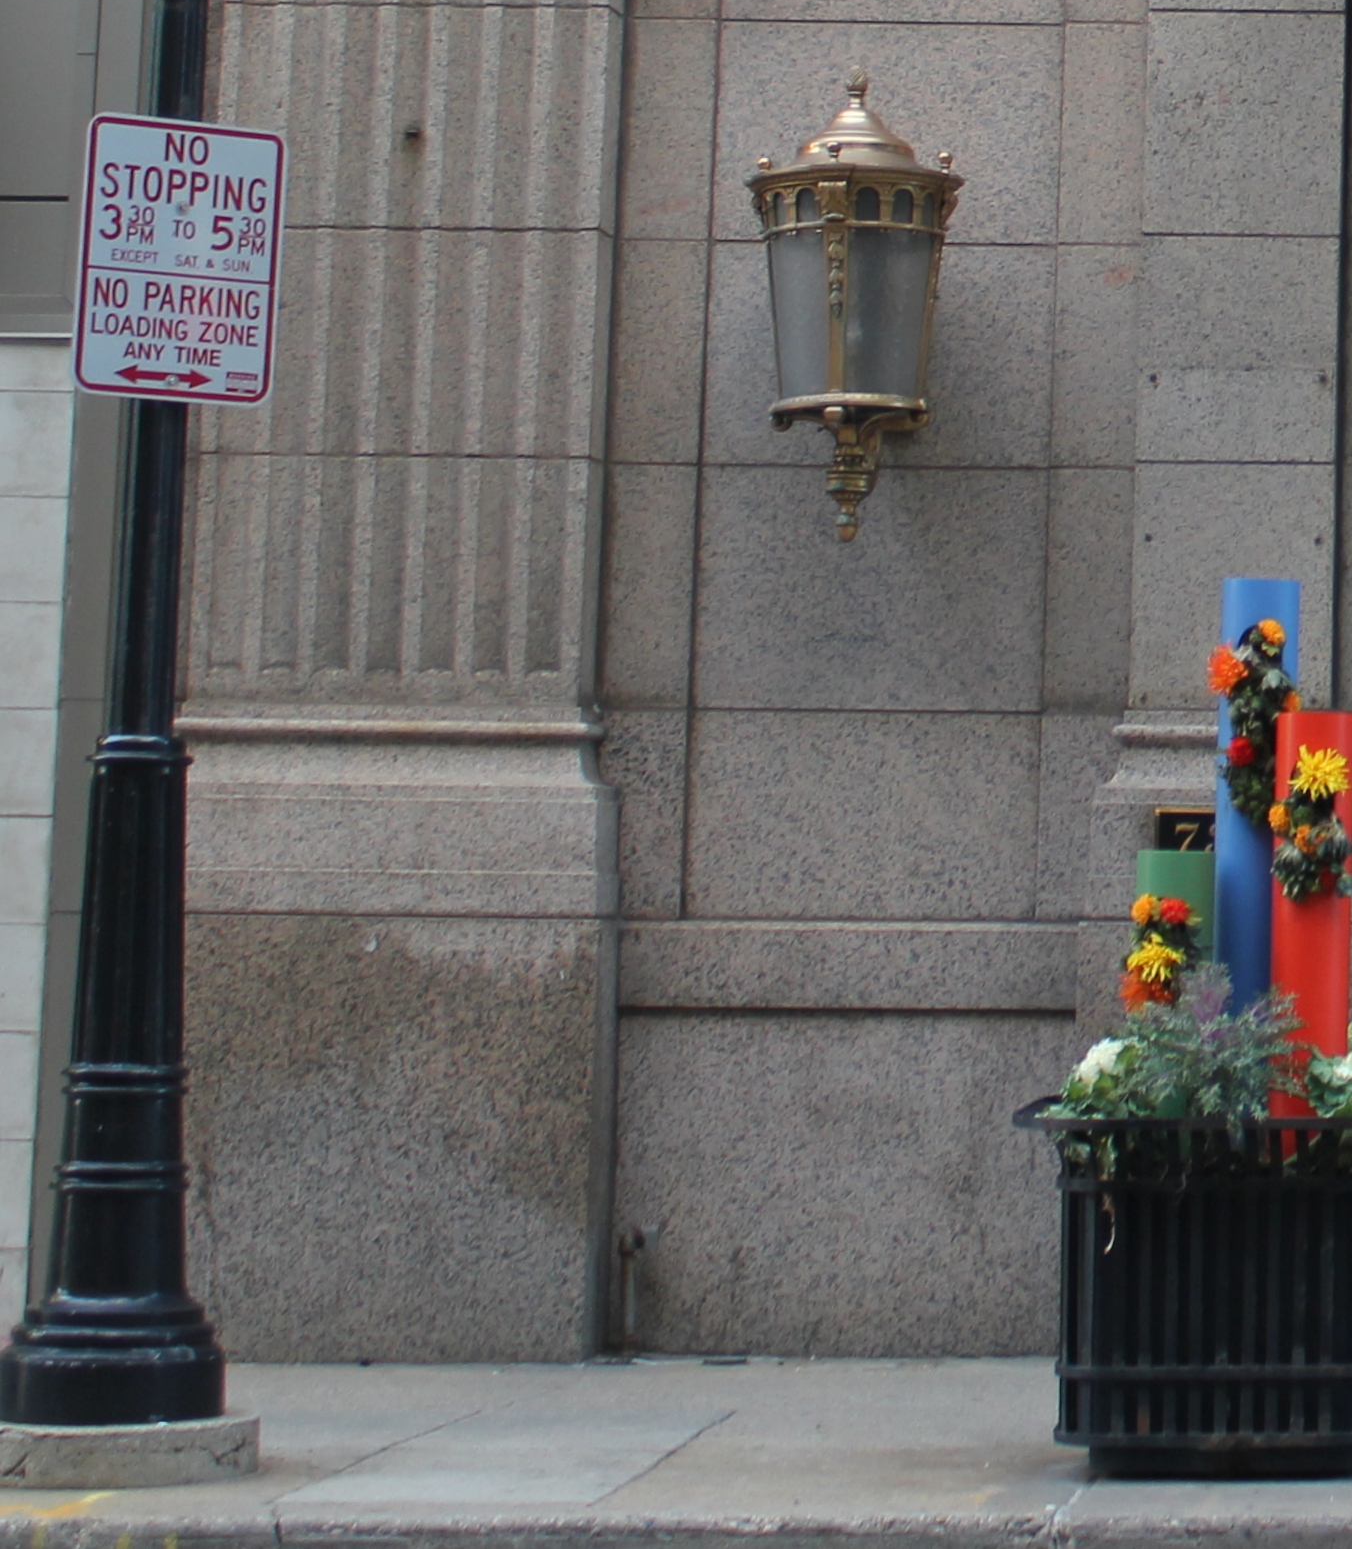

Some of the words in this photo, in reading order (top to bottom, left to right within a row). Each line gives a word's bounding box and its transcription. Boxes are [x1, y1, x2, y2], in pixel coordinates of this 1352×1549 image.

[164, 133, 210, 166] NO
[100, 162, 267, 214] STOPPING
[99, 203, 122, 240] 3
[128, 206, 155, 225] 30
[239, 217, 266, 238] 30
[126, 224, 154, 245] PM
[172, 219, 196, 239] TO
[211, 215, 234, 251] 5
[111, 247, 159, 264] EXCEPT
[205, 258, 215, 269] &
[237, 236, 265, 257] PM
[92, 276, 128, 309] NO
[143, 283, 261, 320] PARKING
[90, 312, 188, 342] LOADING
[198, 321, 259, 347] ZONE
[123, 341, 165, 362] ANY
[174, 345, 222, 367] TIME
